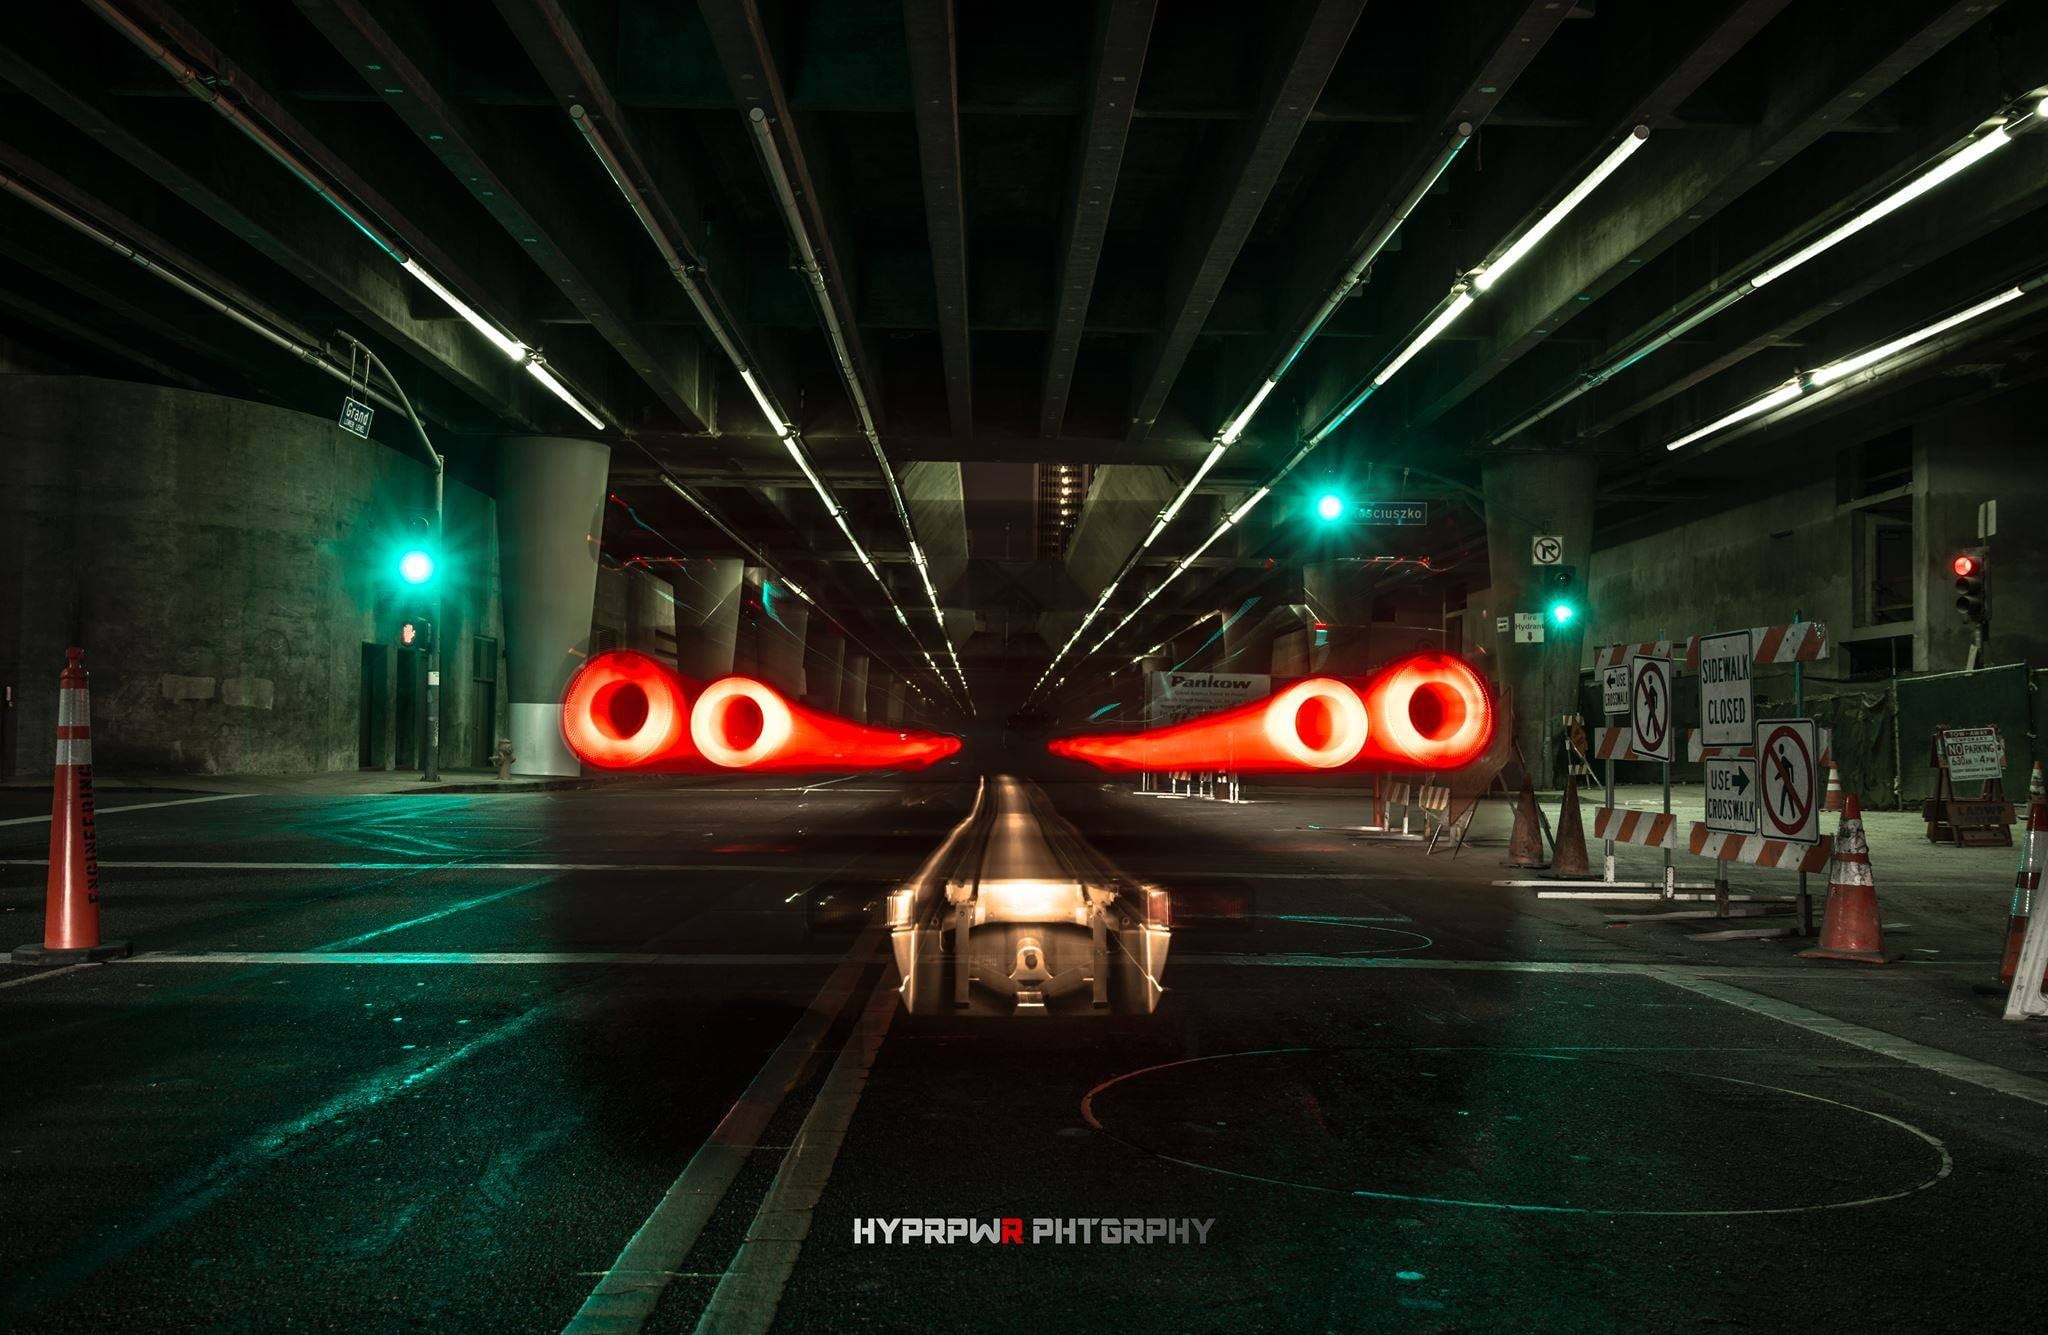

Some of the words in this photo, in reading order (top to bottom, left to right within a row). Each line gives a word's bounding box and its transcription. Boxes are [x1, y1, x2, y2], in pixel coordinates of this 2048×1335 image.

[346, 402, 370, 426] Grand
[1514, 623, 1545, 632] Hydrant
[1702, 654, 1750, 684] SIDEWALK
[1171, 675, 1252, 689] Pankow
[1616, 672, 1627, 687] USE
[1605, 691, 1628, 706] CROSSWALK
[1708, 698, 1745, 725] CLOSED
[1948, 744, 1963, 756] NO
[1964, 744, 1995, 753] PARKING
[1711, 770, 1730, 790] USE
[1708, 798, 1754, 822] CROSSWALK
[79, 764, 98, 905] ENGINEERING
